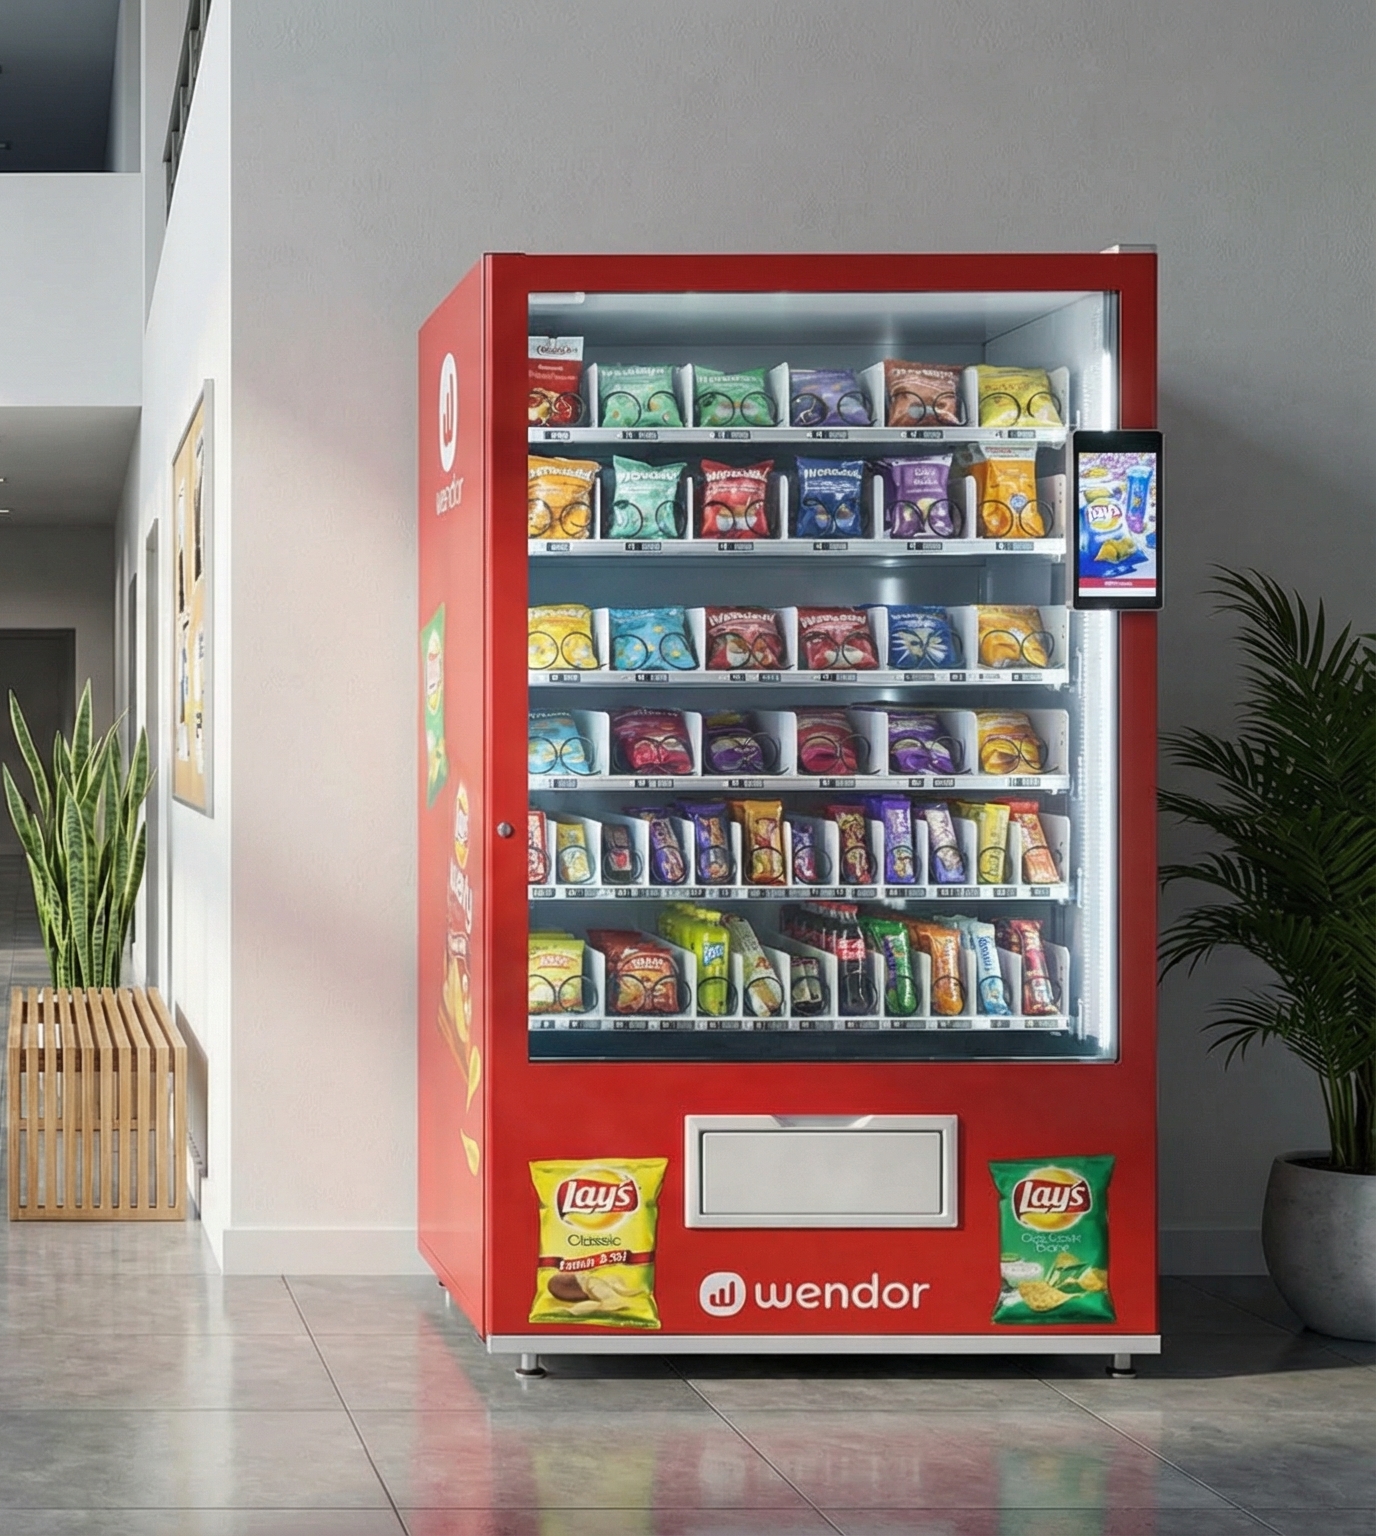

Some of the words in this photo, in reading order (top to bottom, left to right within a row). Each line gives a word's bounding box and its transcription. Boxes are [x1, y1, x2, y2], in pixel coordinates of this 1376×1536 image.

[562, 1180, 634, 1214] Lay's
[1019, 1180, 1086, 1214] Lay's
[754, 1271, 931, 1309] wendor
